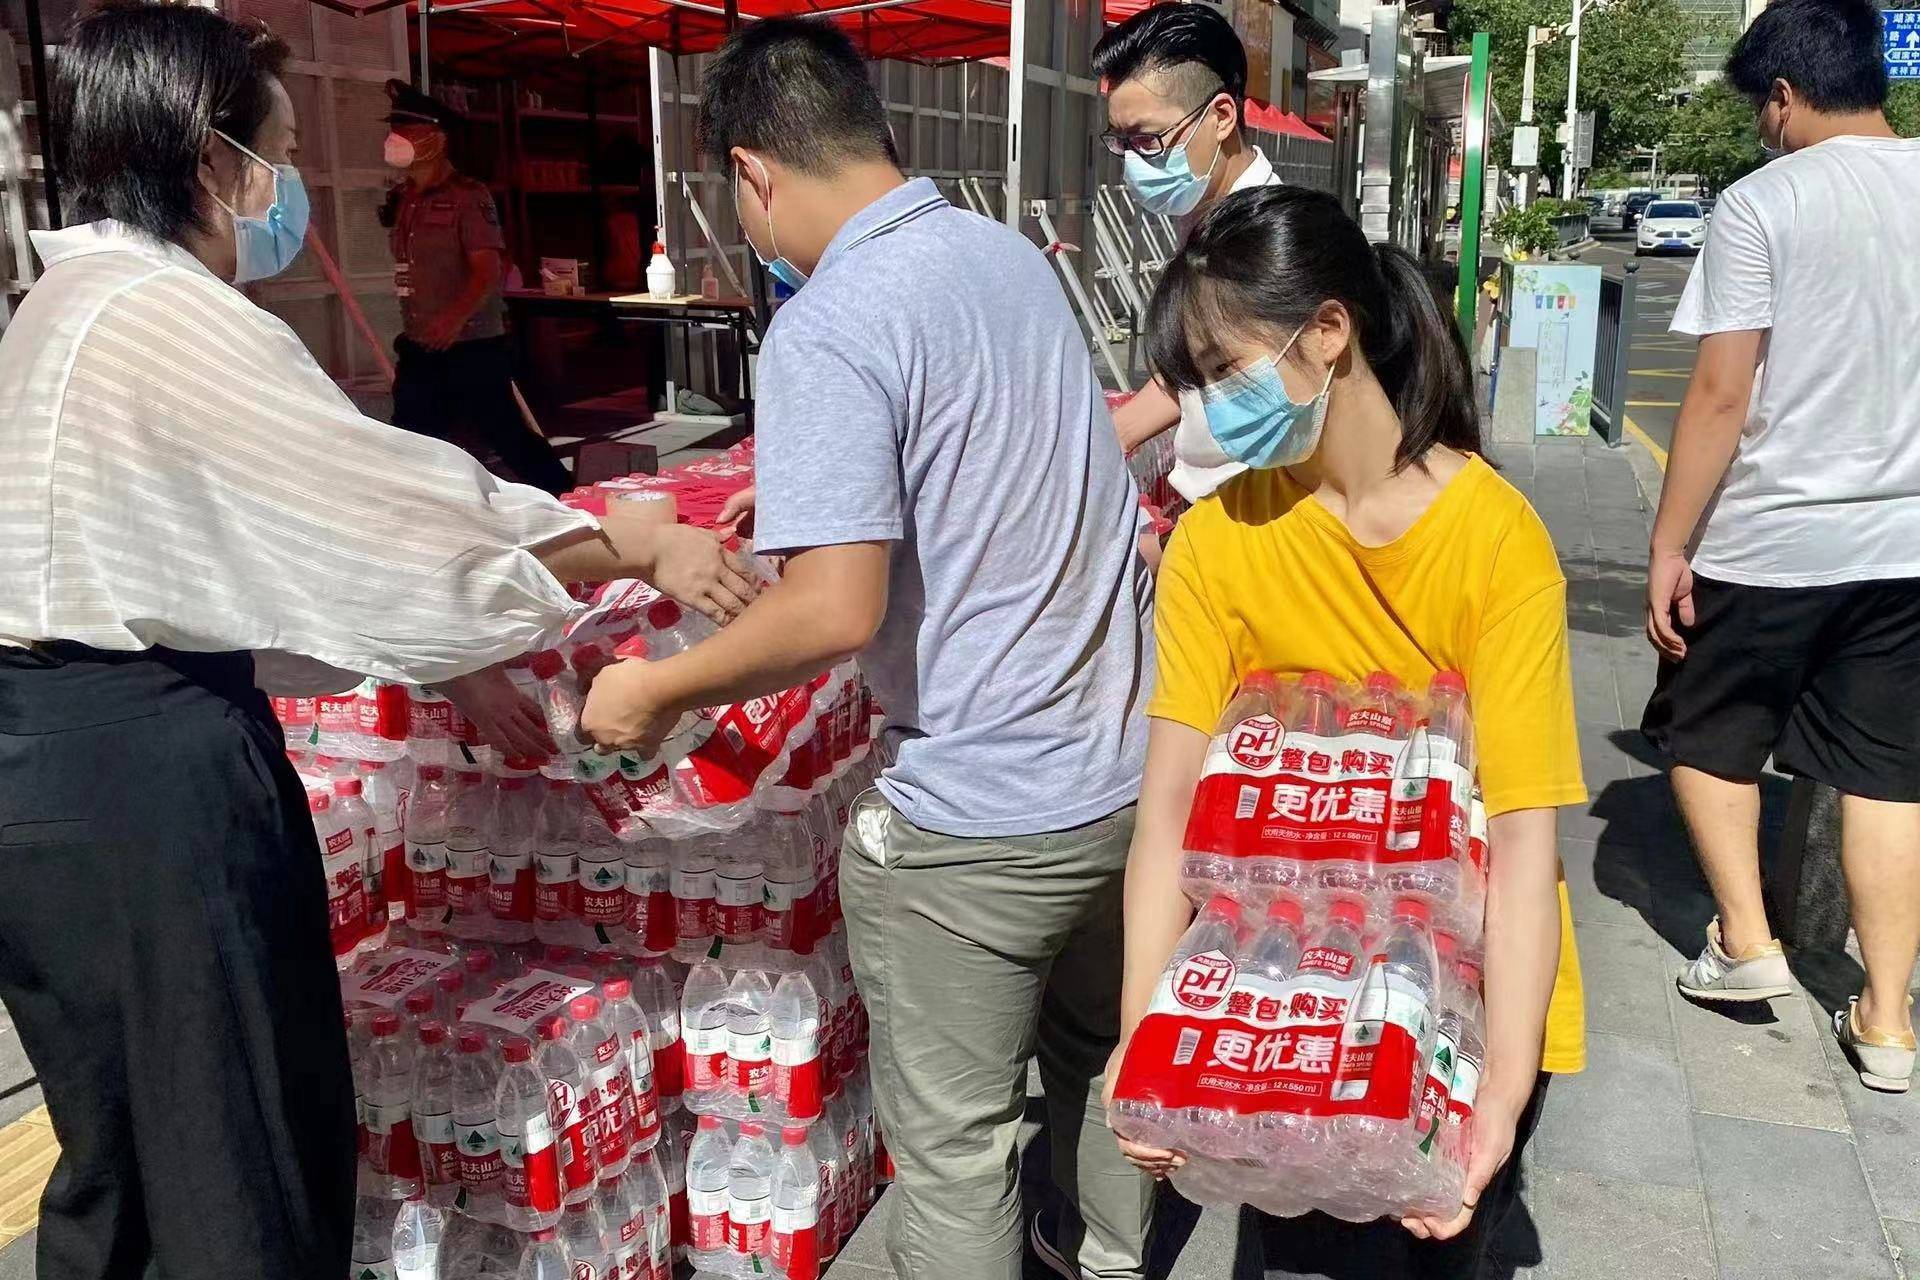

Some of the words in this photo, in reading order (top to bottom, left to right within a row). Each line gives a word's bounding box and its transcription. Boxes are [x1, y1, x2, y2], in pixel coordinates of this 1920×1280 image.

[1267, 784, 1388, 824] 更优惠
[1302, 950, 1350, 967] 农夫山泉
[1206, 1028, 1338, 1074] 更优惠
